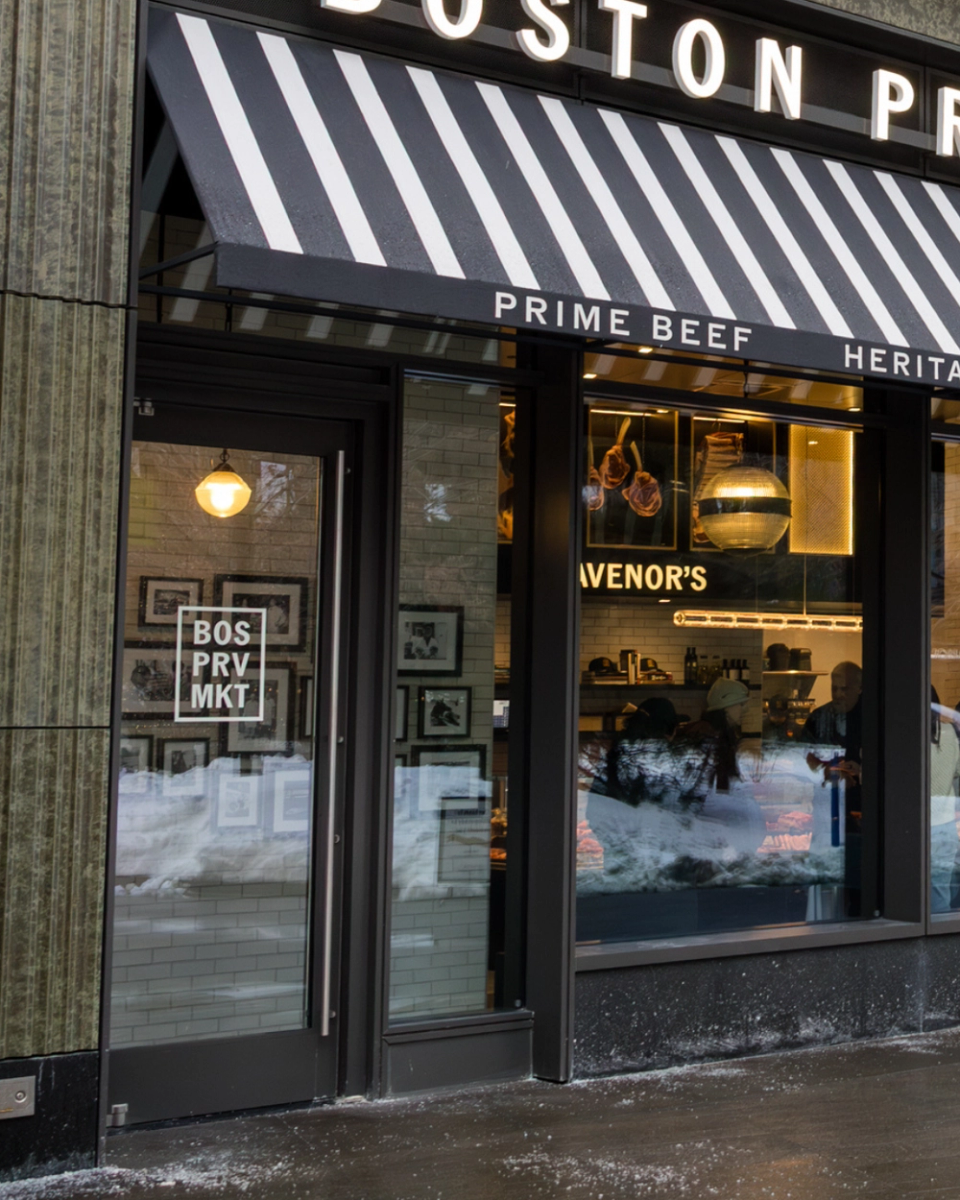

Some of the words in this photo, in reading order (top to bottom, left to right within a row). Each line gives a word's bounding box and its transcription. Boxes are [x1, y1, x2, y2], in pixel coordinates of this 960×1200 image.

[494, 291, 630, 337] PRIME
[652, 314, 752, 352] BEEF
[193, 620, 250, 645] BOS
[192, 652, 250, 677] PRV
[190, 683, 249, 709] MKT
